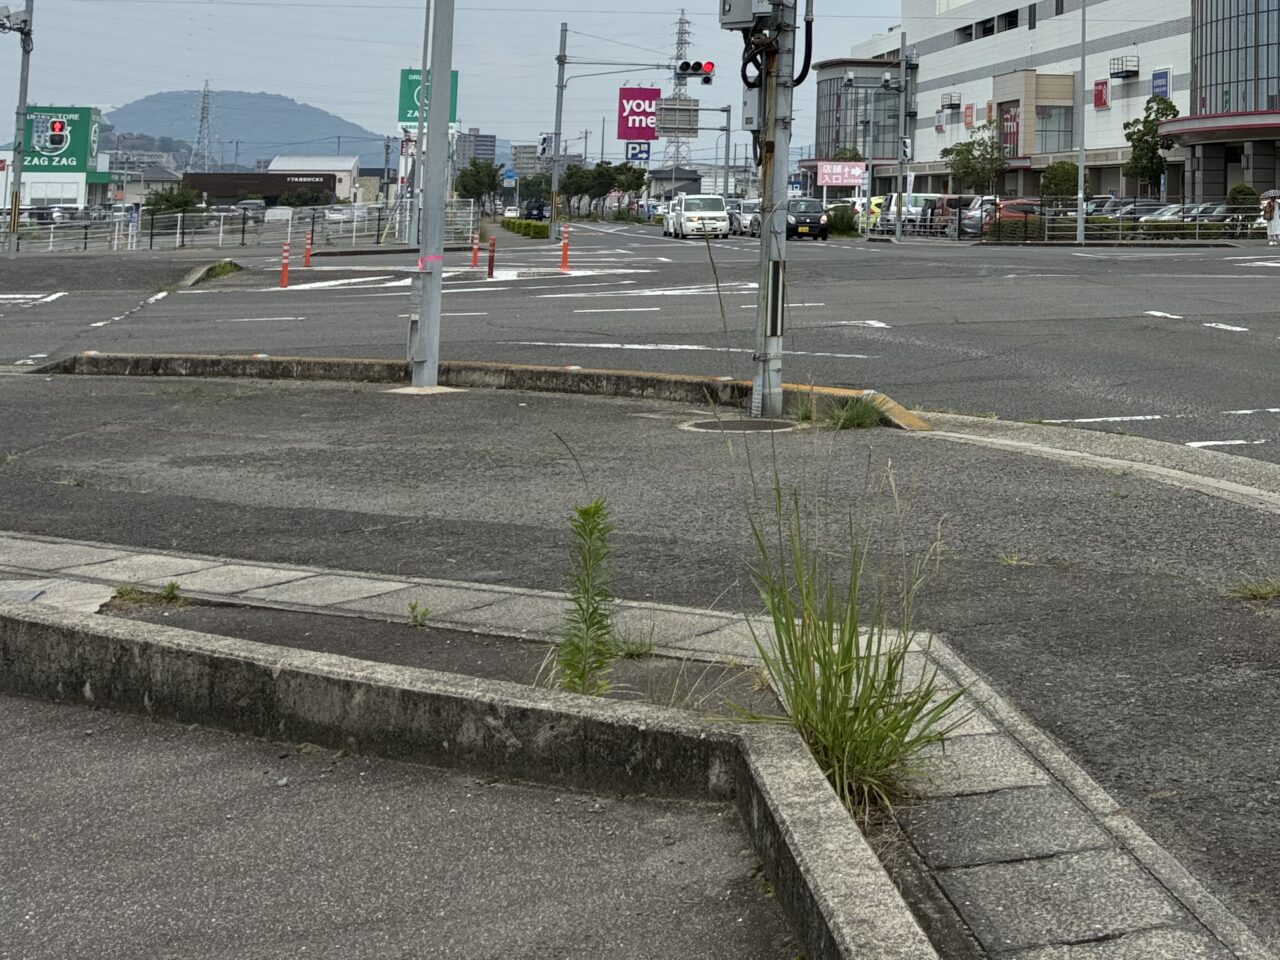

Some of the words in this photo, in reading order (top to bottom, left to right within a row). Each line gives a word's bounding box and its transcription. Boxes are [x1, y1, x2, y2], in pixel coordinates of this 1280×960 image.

[622, 99, 656, 117] you
[627, 115, 656, 128] me
[628, 144, 640, 159] P
[23, 156, 49, 166] ZAG
[52, 156, 77, 166] ZAG
[822, 175, 842, 184] 入口
